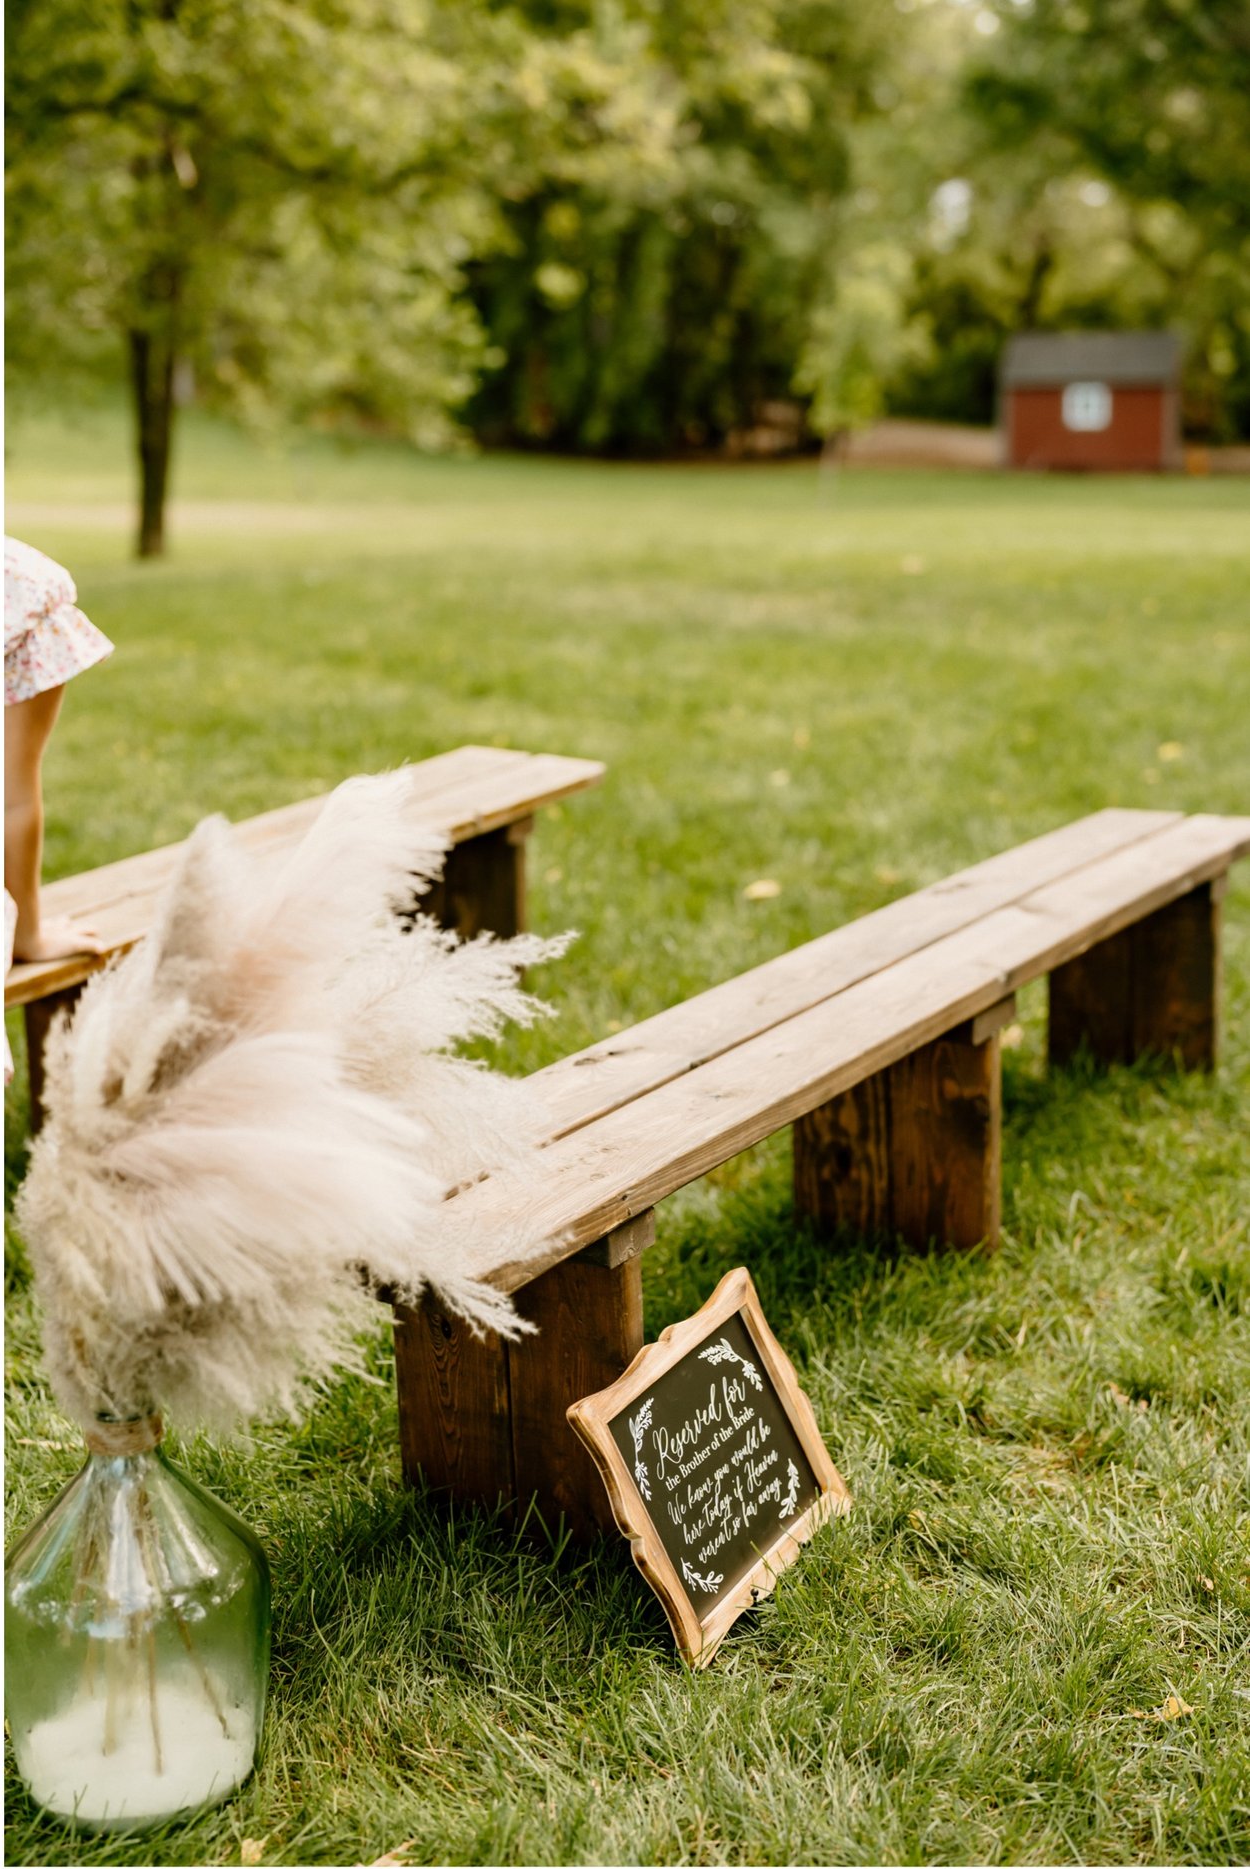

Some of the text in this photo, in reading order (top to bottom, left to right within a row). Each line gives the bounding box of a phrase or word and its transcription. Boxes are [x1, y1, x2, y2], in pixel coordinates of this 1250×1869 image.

[652, 1376, 746, 1480] Reserved for
[665, 1406, 755, 1491] the Brother of the Bride
[667, 1417, 771, 1525] We know you would be
[683, 1519, 706, 1544] here
[732, 1475, 743, 1501] if
[744, 1449, 779, 1493] Heaven
[732, 1517, 742, 1536] so
[742, 1501, 758, 1528] far
